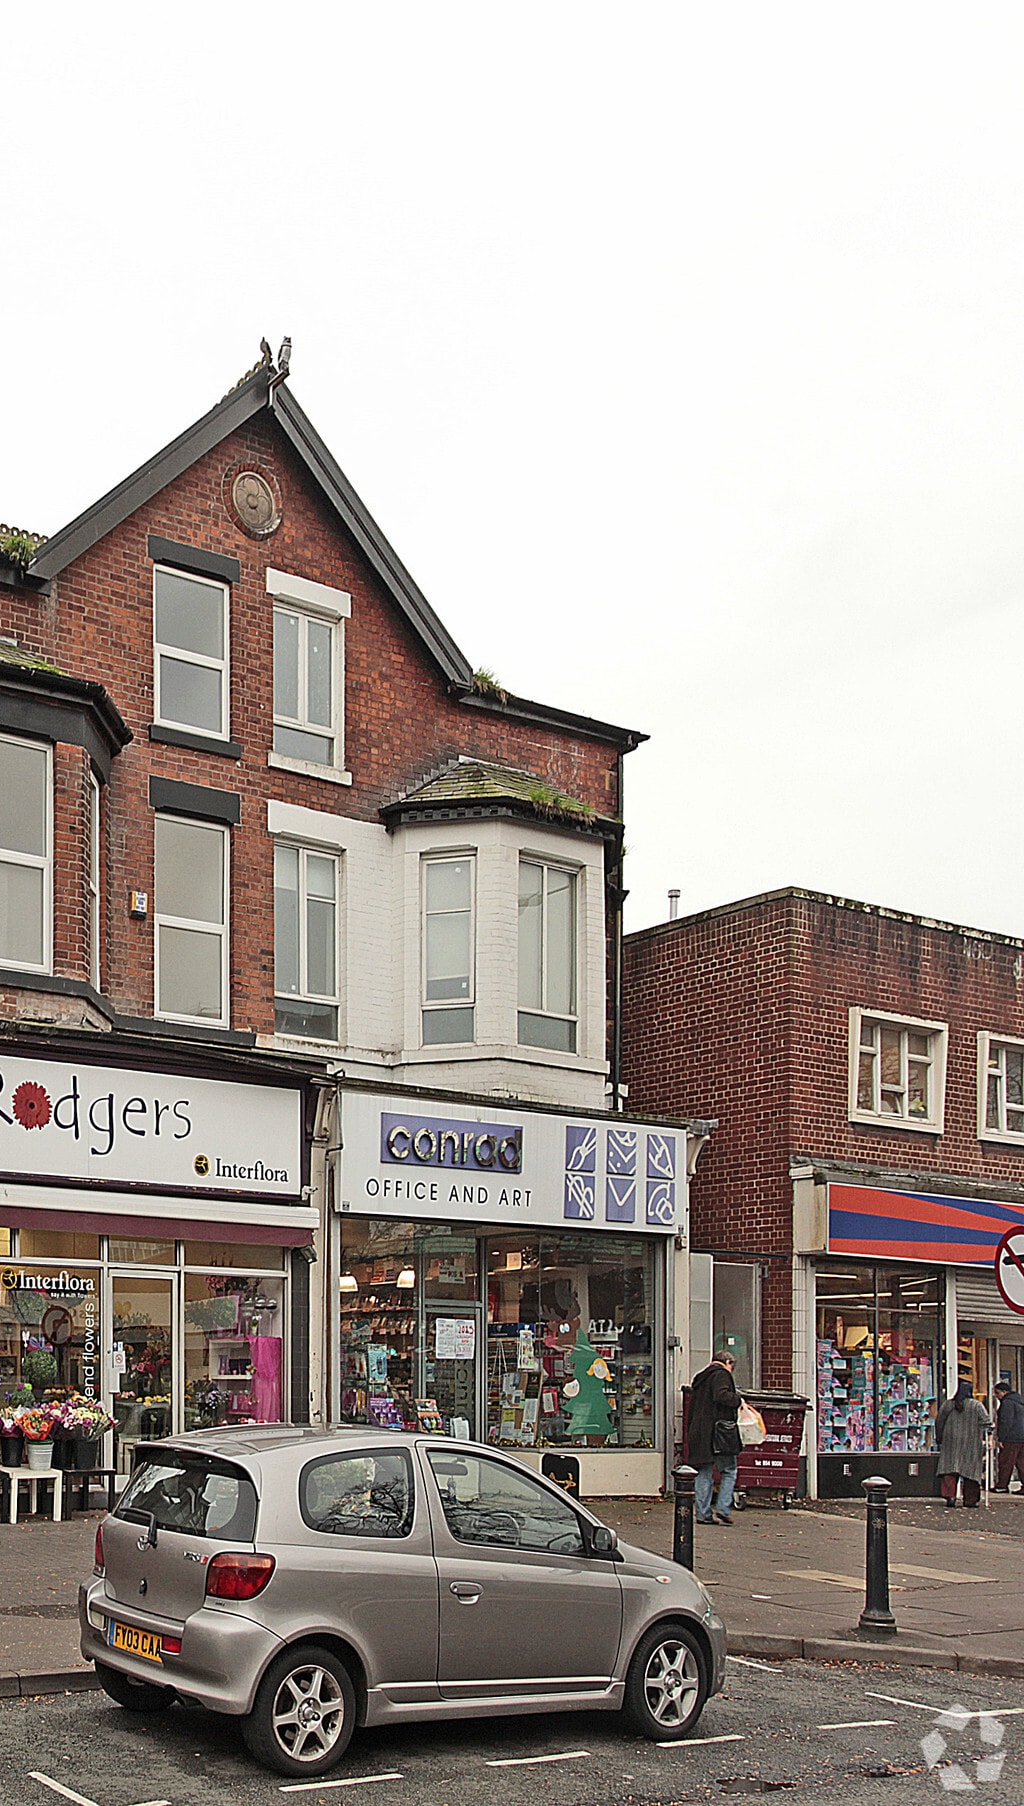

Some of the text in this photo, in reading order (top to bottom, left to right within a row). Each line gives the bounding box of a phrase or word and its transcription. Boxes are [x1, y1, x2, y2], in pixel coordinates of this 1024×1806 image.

[387, 1125, 522, 1168] conrad
[216, 1157, 289, 1182] Interflora
[366, 1178, 532, 1207] OFFICE AND ART
[19, 1270, 96, 1291] Interflora
[82, 1303, 95, 1362] flowers
[115, 1624, 161, 1657] FY03 CAA
